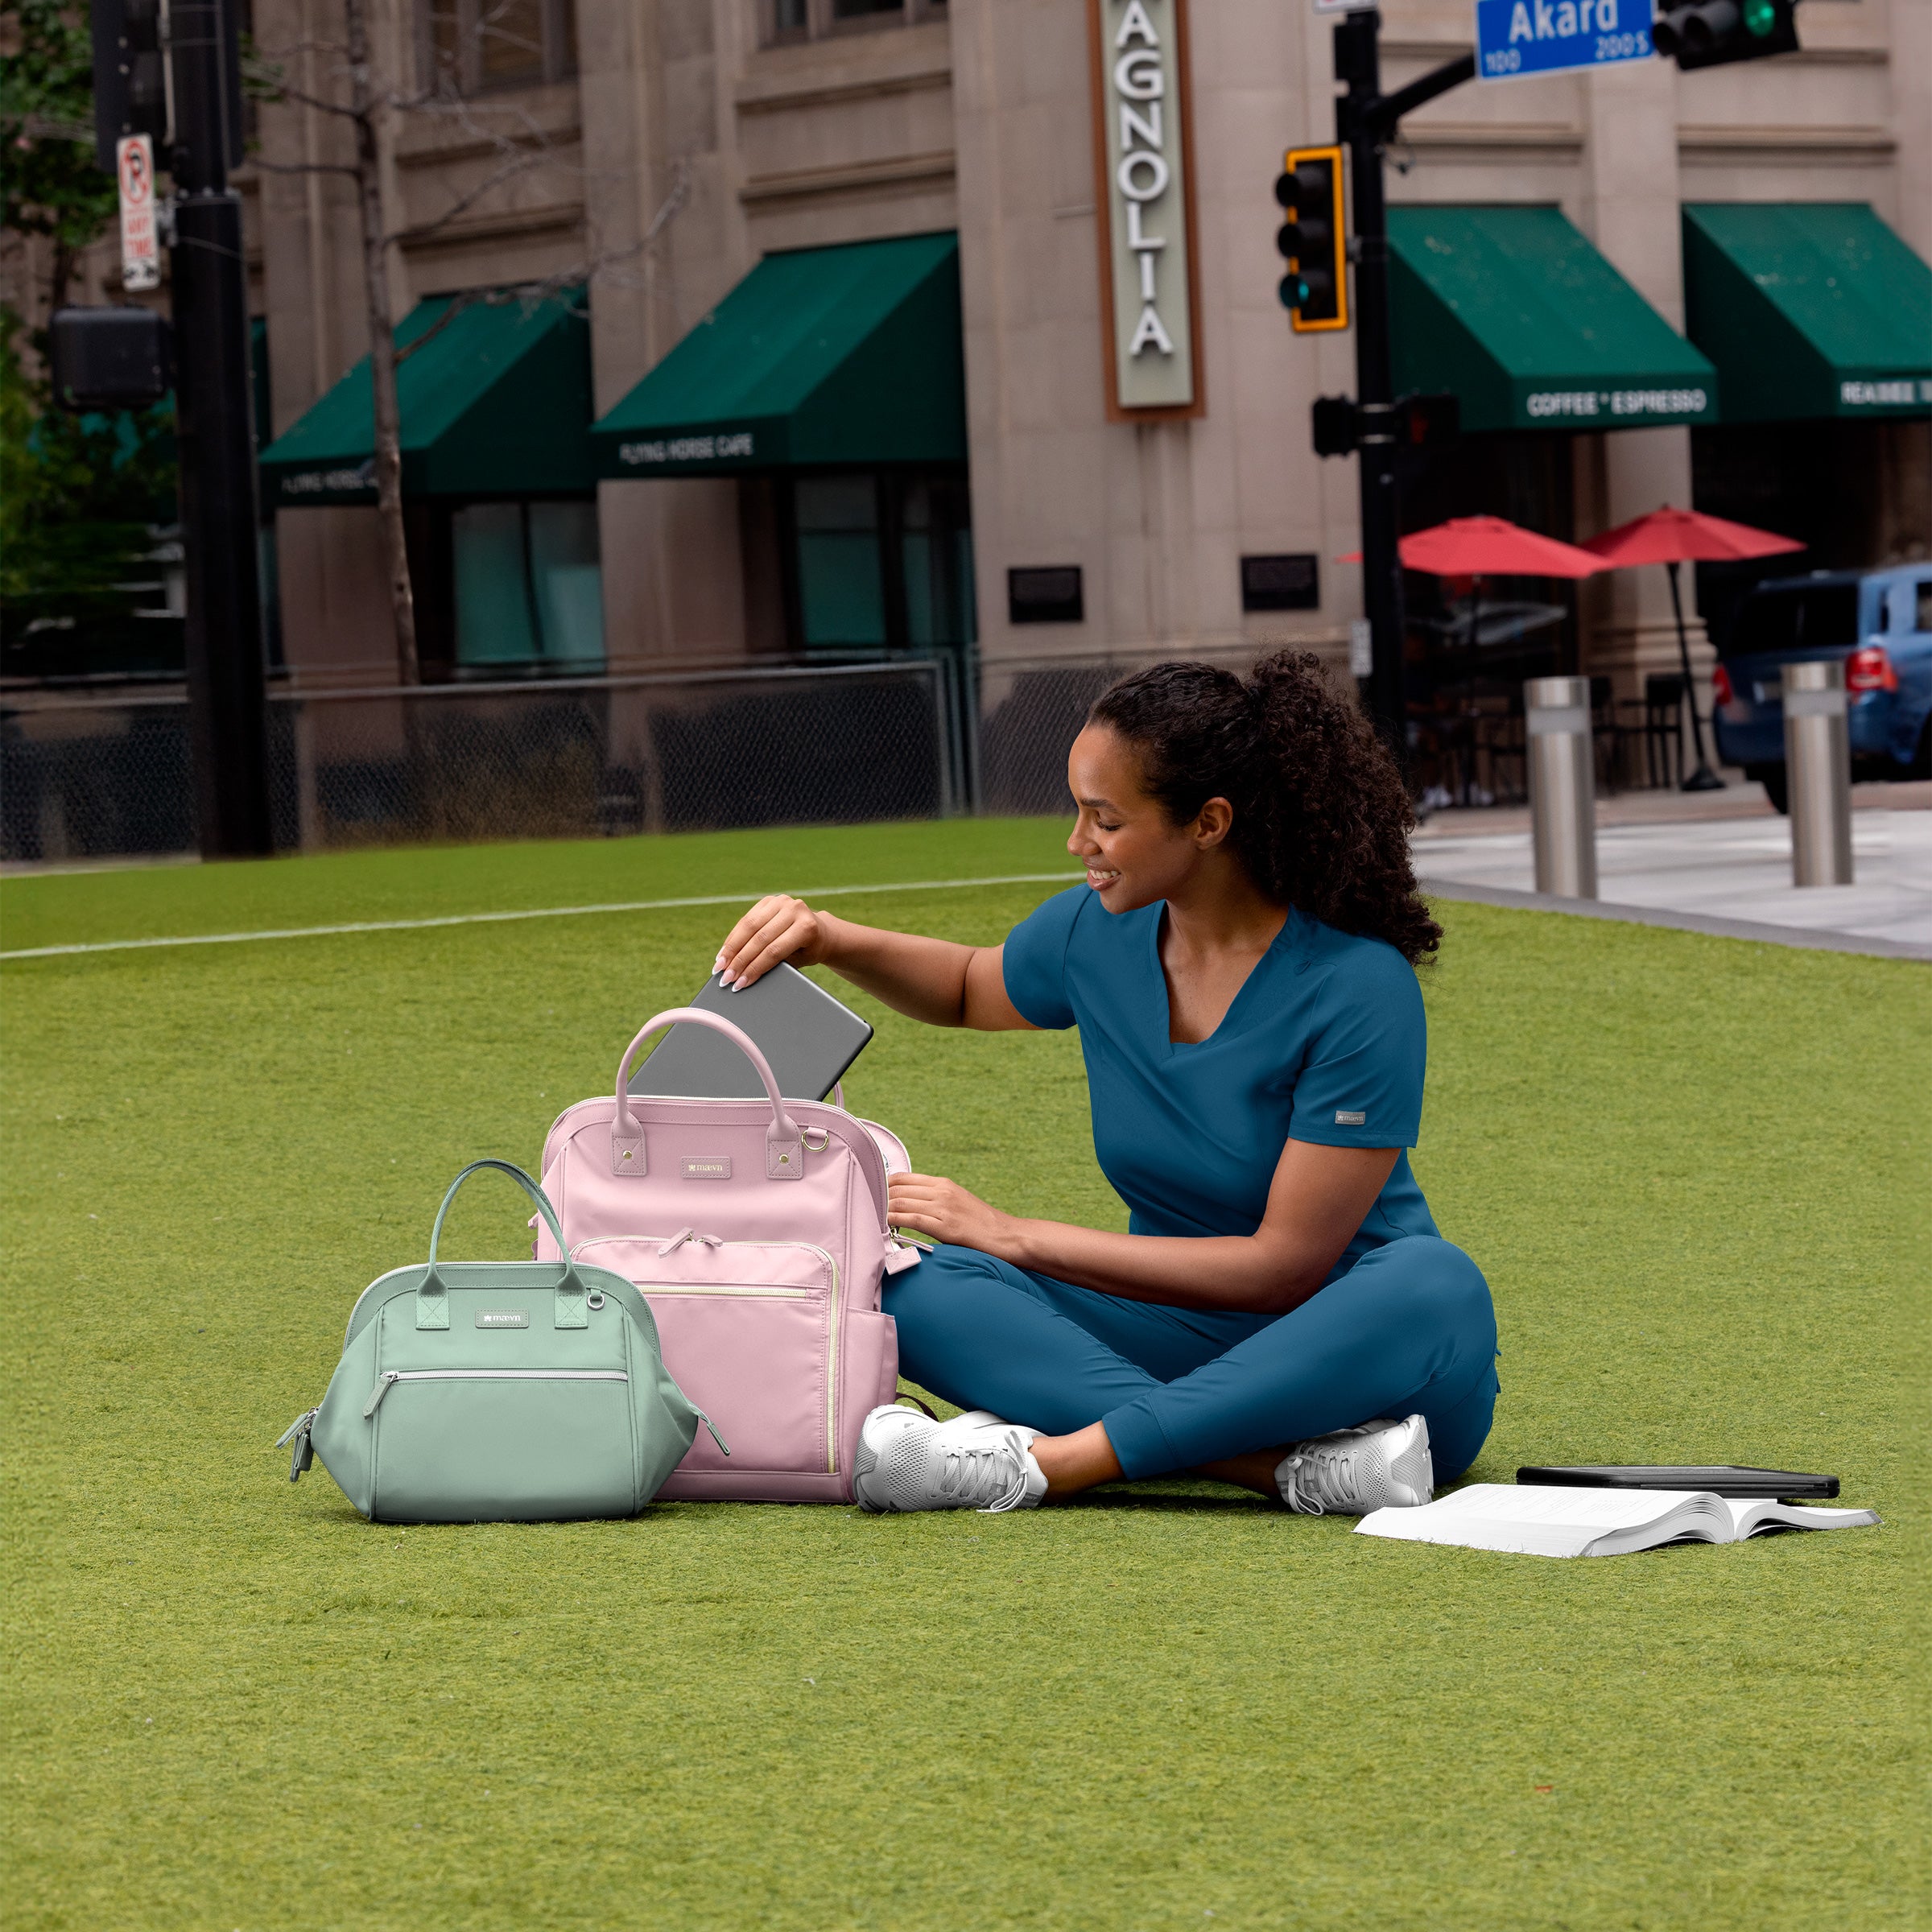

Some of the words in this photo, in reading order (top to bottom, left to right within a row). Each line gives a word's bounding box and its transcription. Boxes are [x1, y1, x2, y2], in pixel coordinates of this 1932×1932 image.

[1509, 0, 1618, 44] Akard
[1486, 48, 1521, 73] 100
[1114, 0, 1174, 355] AGNOLIA
[1526, 391, 1600, 418] COFFEE
[1612, 388, 1707, 415] ESPRESSO
